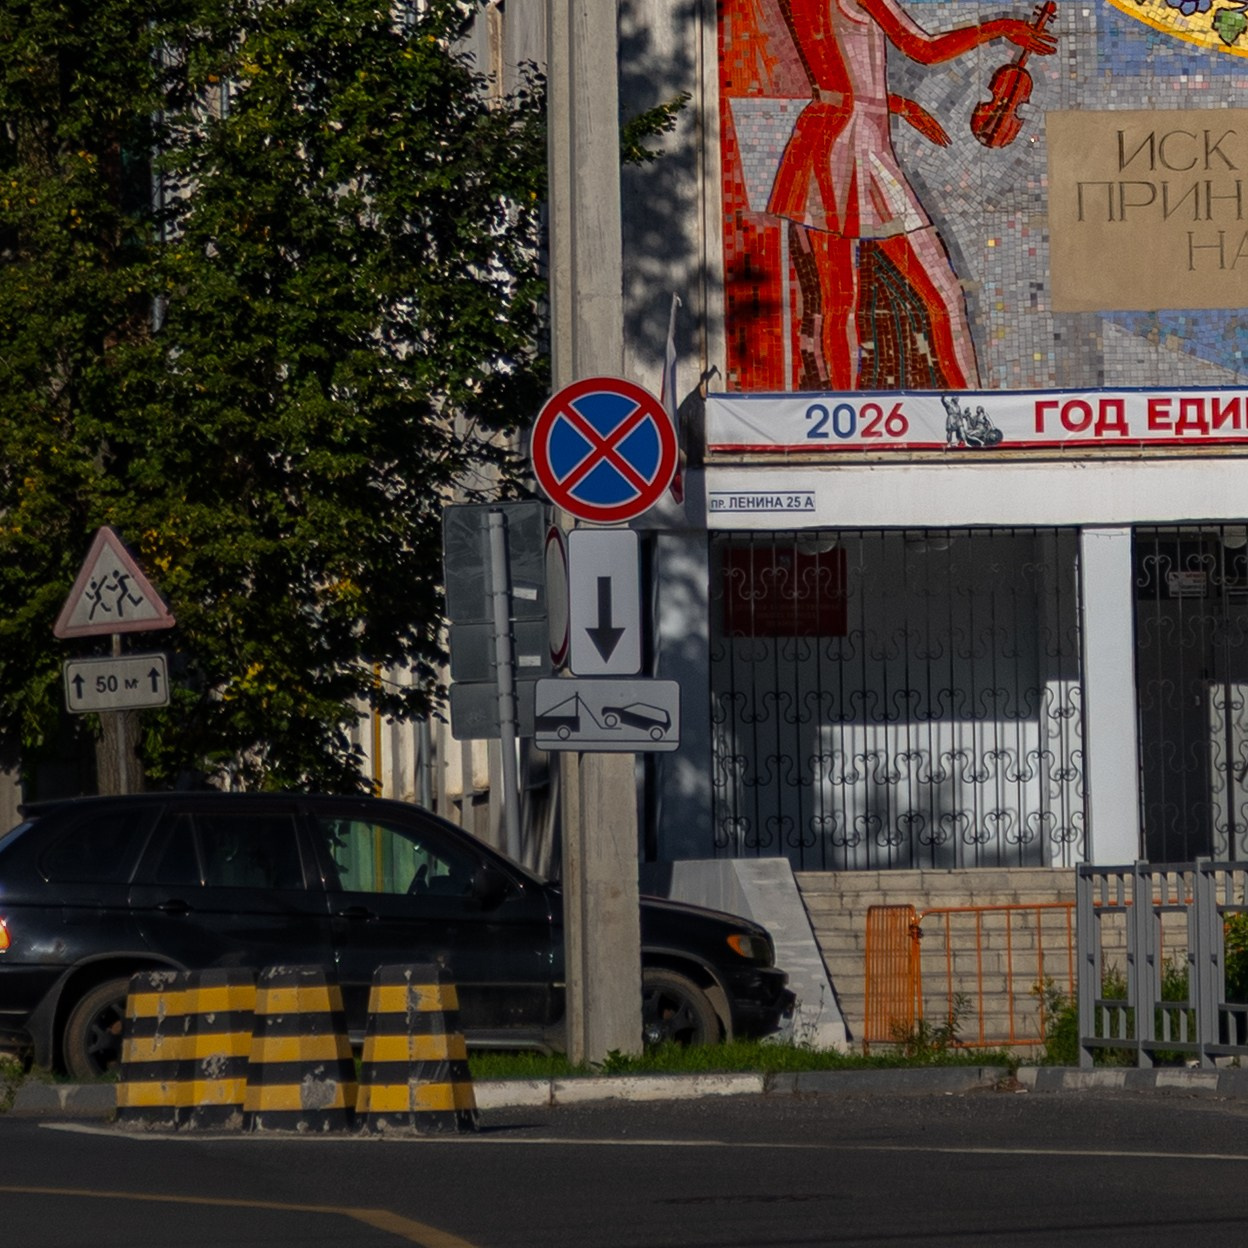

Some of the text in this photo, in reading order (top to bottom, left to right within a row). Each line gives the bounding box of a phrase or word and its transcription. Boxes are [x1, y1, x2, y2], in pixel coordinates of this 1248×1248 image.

[805, 403, 910, 440] 2026
[1035, 398, 1129, 437] ГОД
[729, 496, 783, 509] ЛЕНИНА
[786, 496, 802, 508] 25
[96, 675, 118, 693] 50
